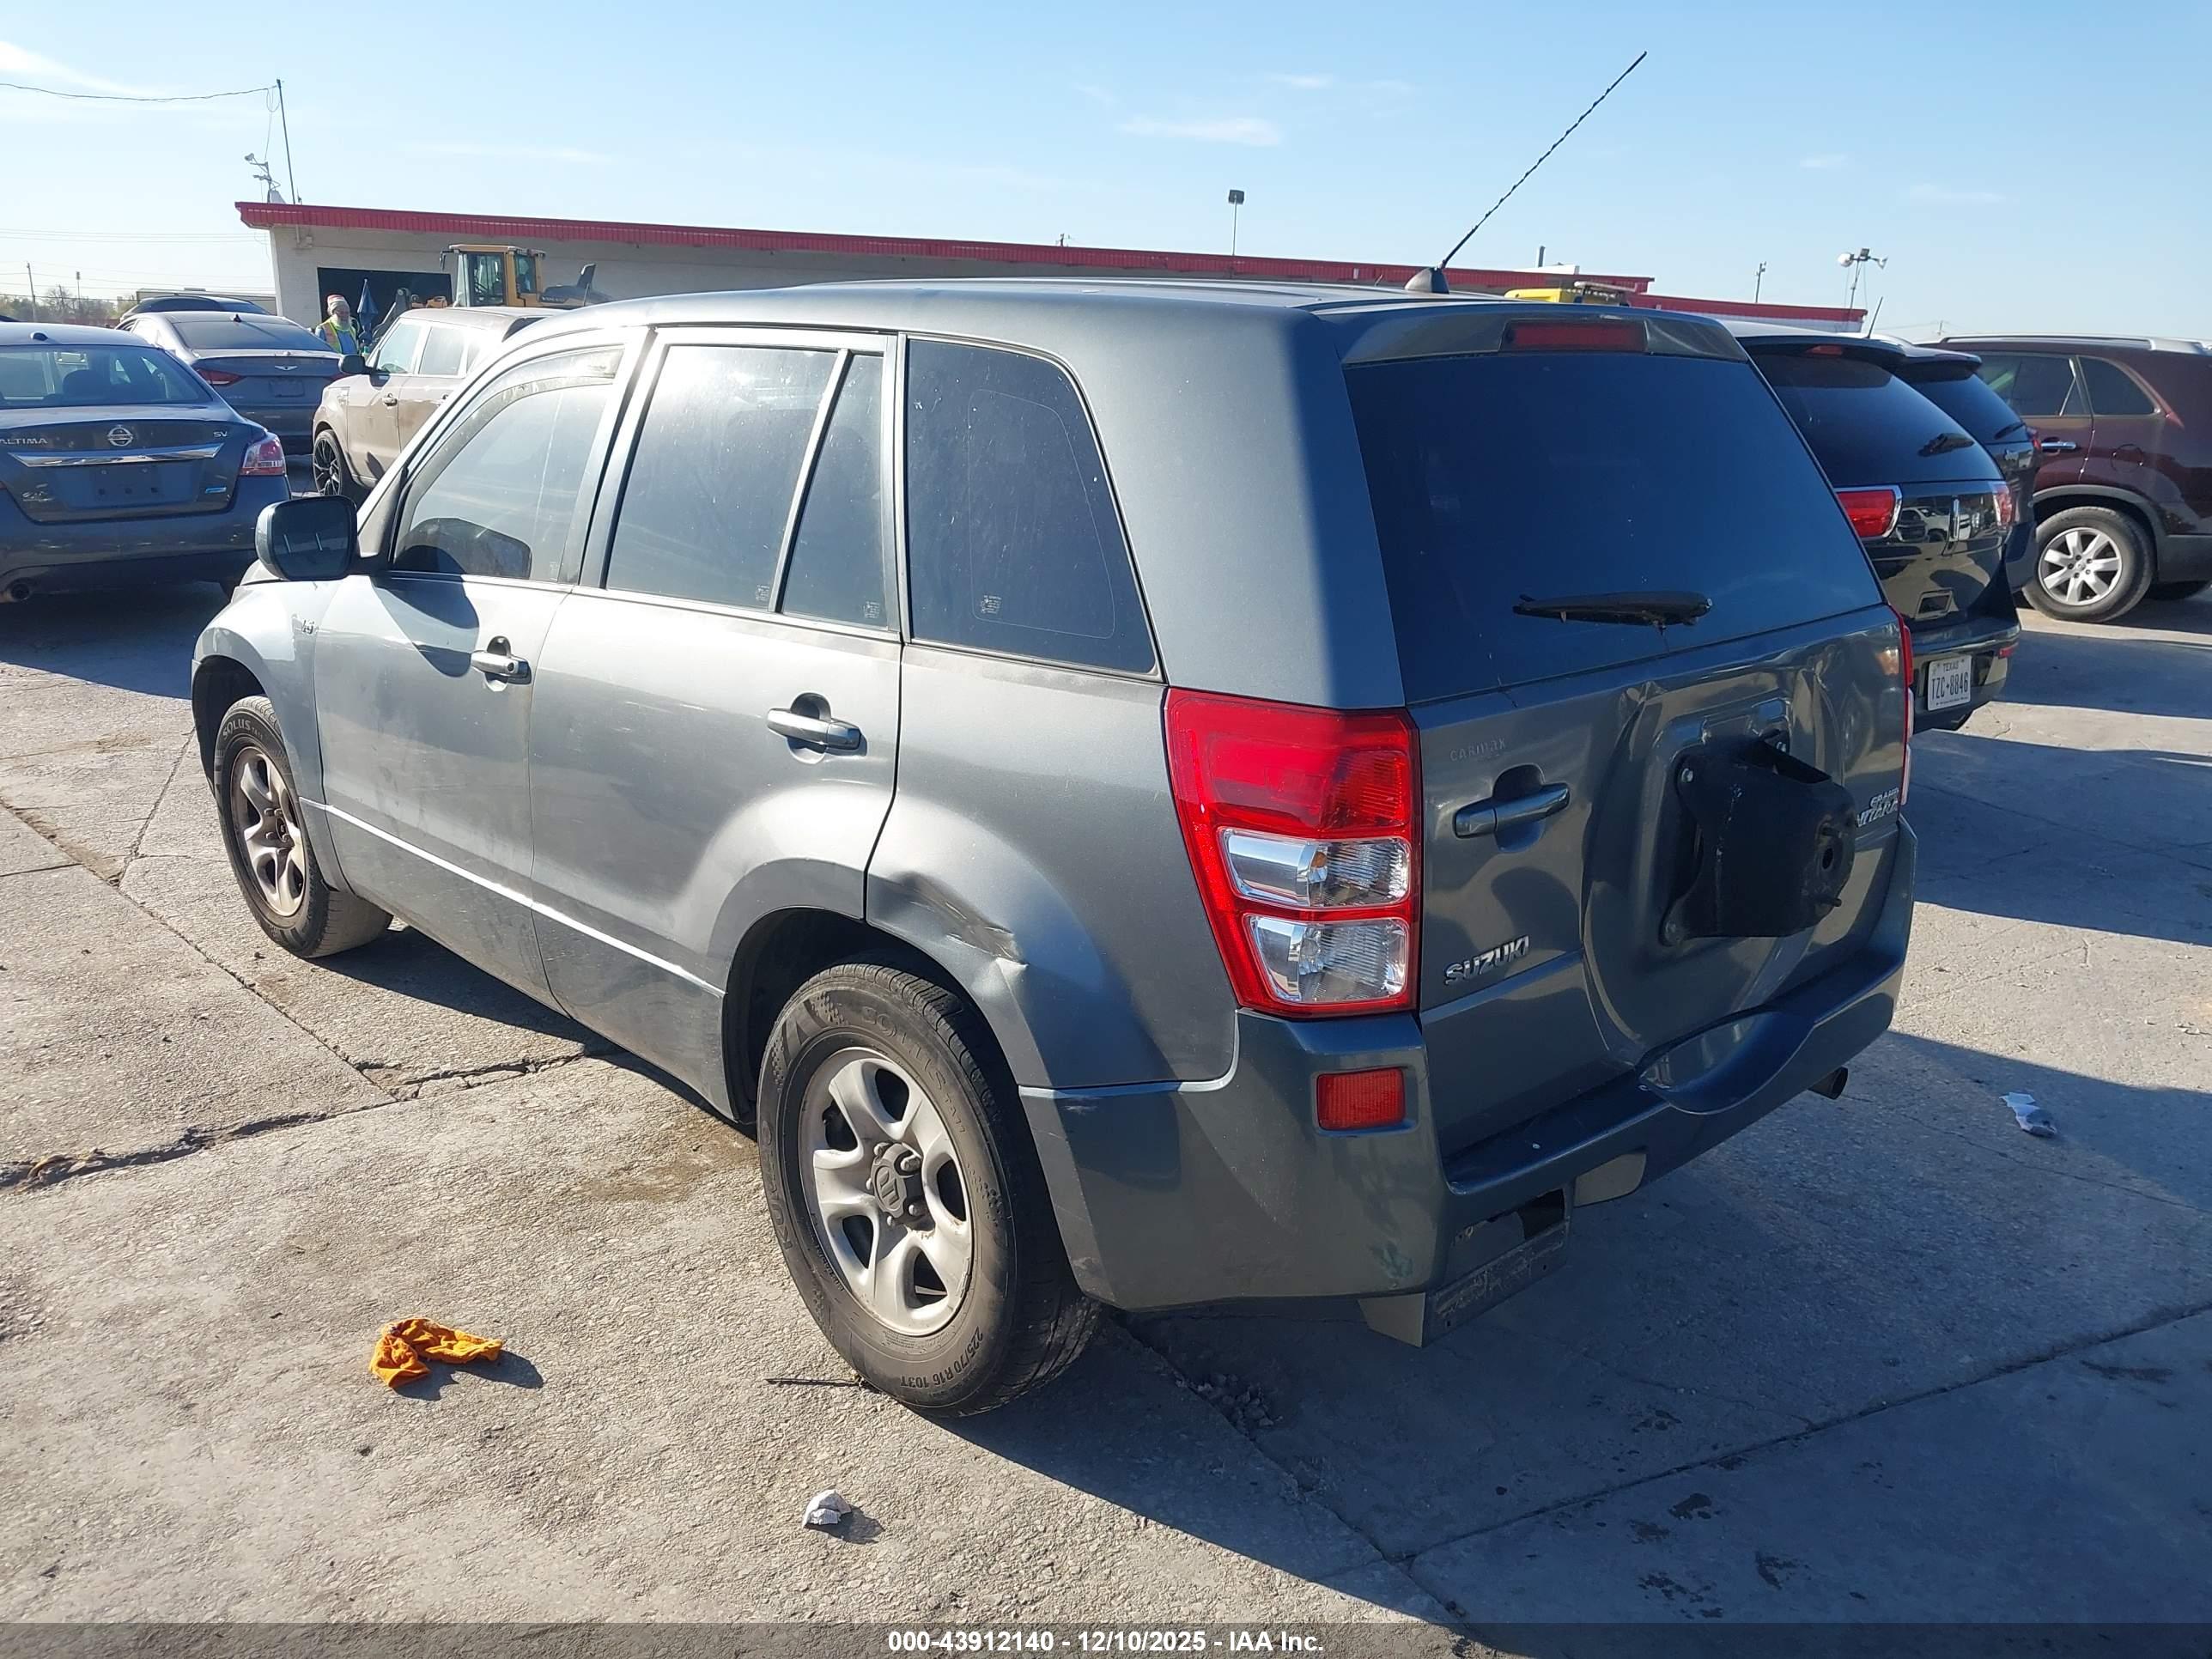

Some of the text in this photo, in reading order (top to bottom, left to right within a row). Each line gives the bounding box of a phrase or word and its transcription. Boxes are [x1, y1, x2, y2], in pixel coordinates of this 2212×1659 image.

[222, 718, 251, 740] SOLUS
[1444, 934, 1529, 985] SUZUKI
[954, 1325, 983, 1374] 225/70
[900, 1376, 929, 1389] 103T
[933, 1366, 954, 1386] R16
